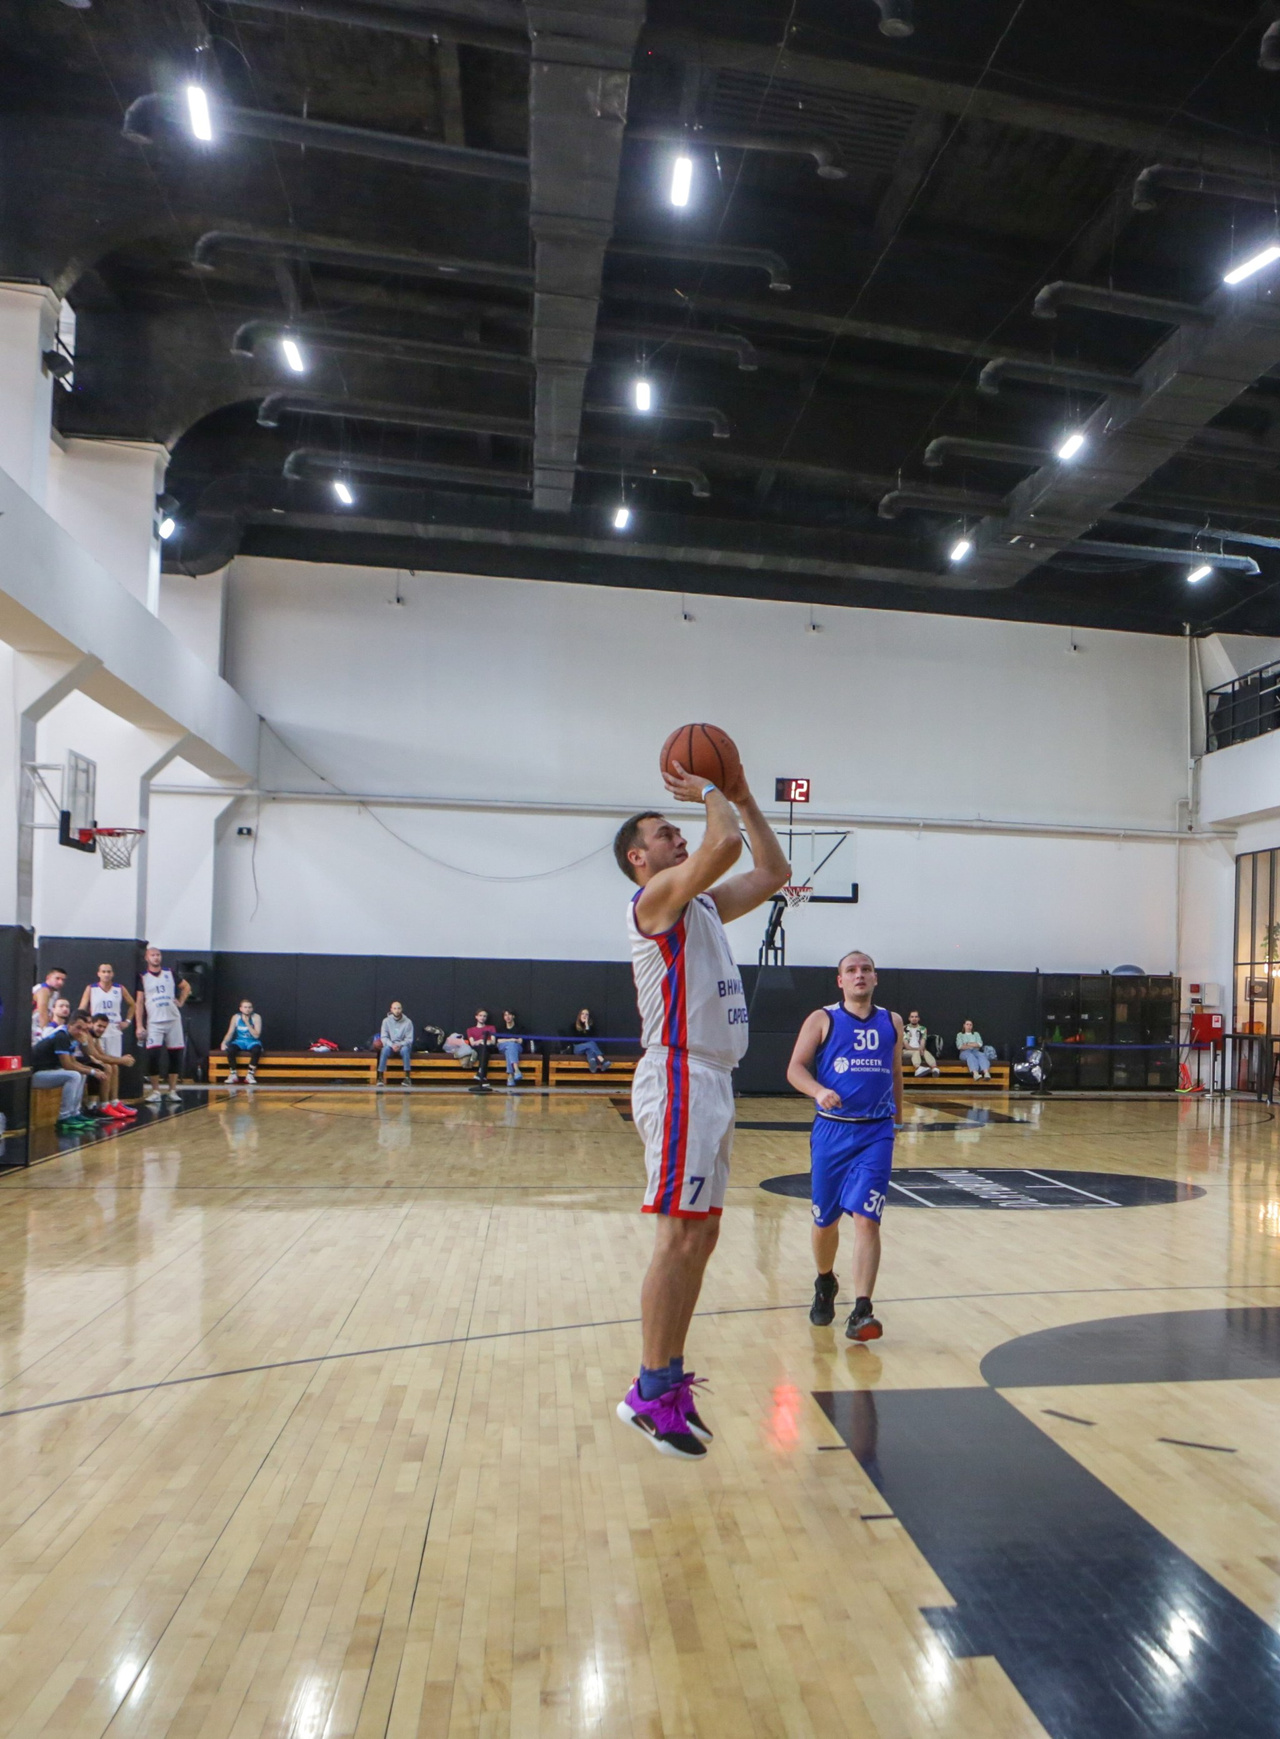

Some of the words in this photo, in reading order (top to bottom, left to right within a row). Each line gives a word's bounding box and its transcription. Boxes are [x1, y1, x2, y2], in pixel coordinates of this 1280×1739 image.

[790, 780, 808, 801] 12
[155, 984, 166, 994] 13
[102, 1000, 113, 1010] 10
[853, 1029, 880, 1051] 30
[850, 1058, 883, 1067] РОССЕТИ
[688, 1175, 706, 1206] 7
[863, 1189, 887, 1217] 30
